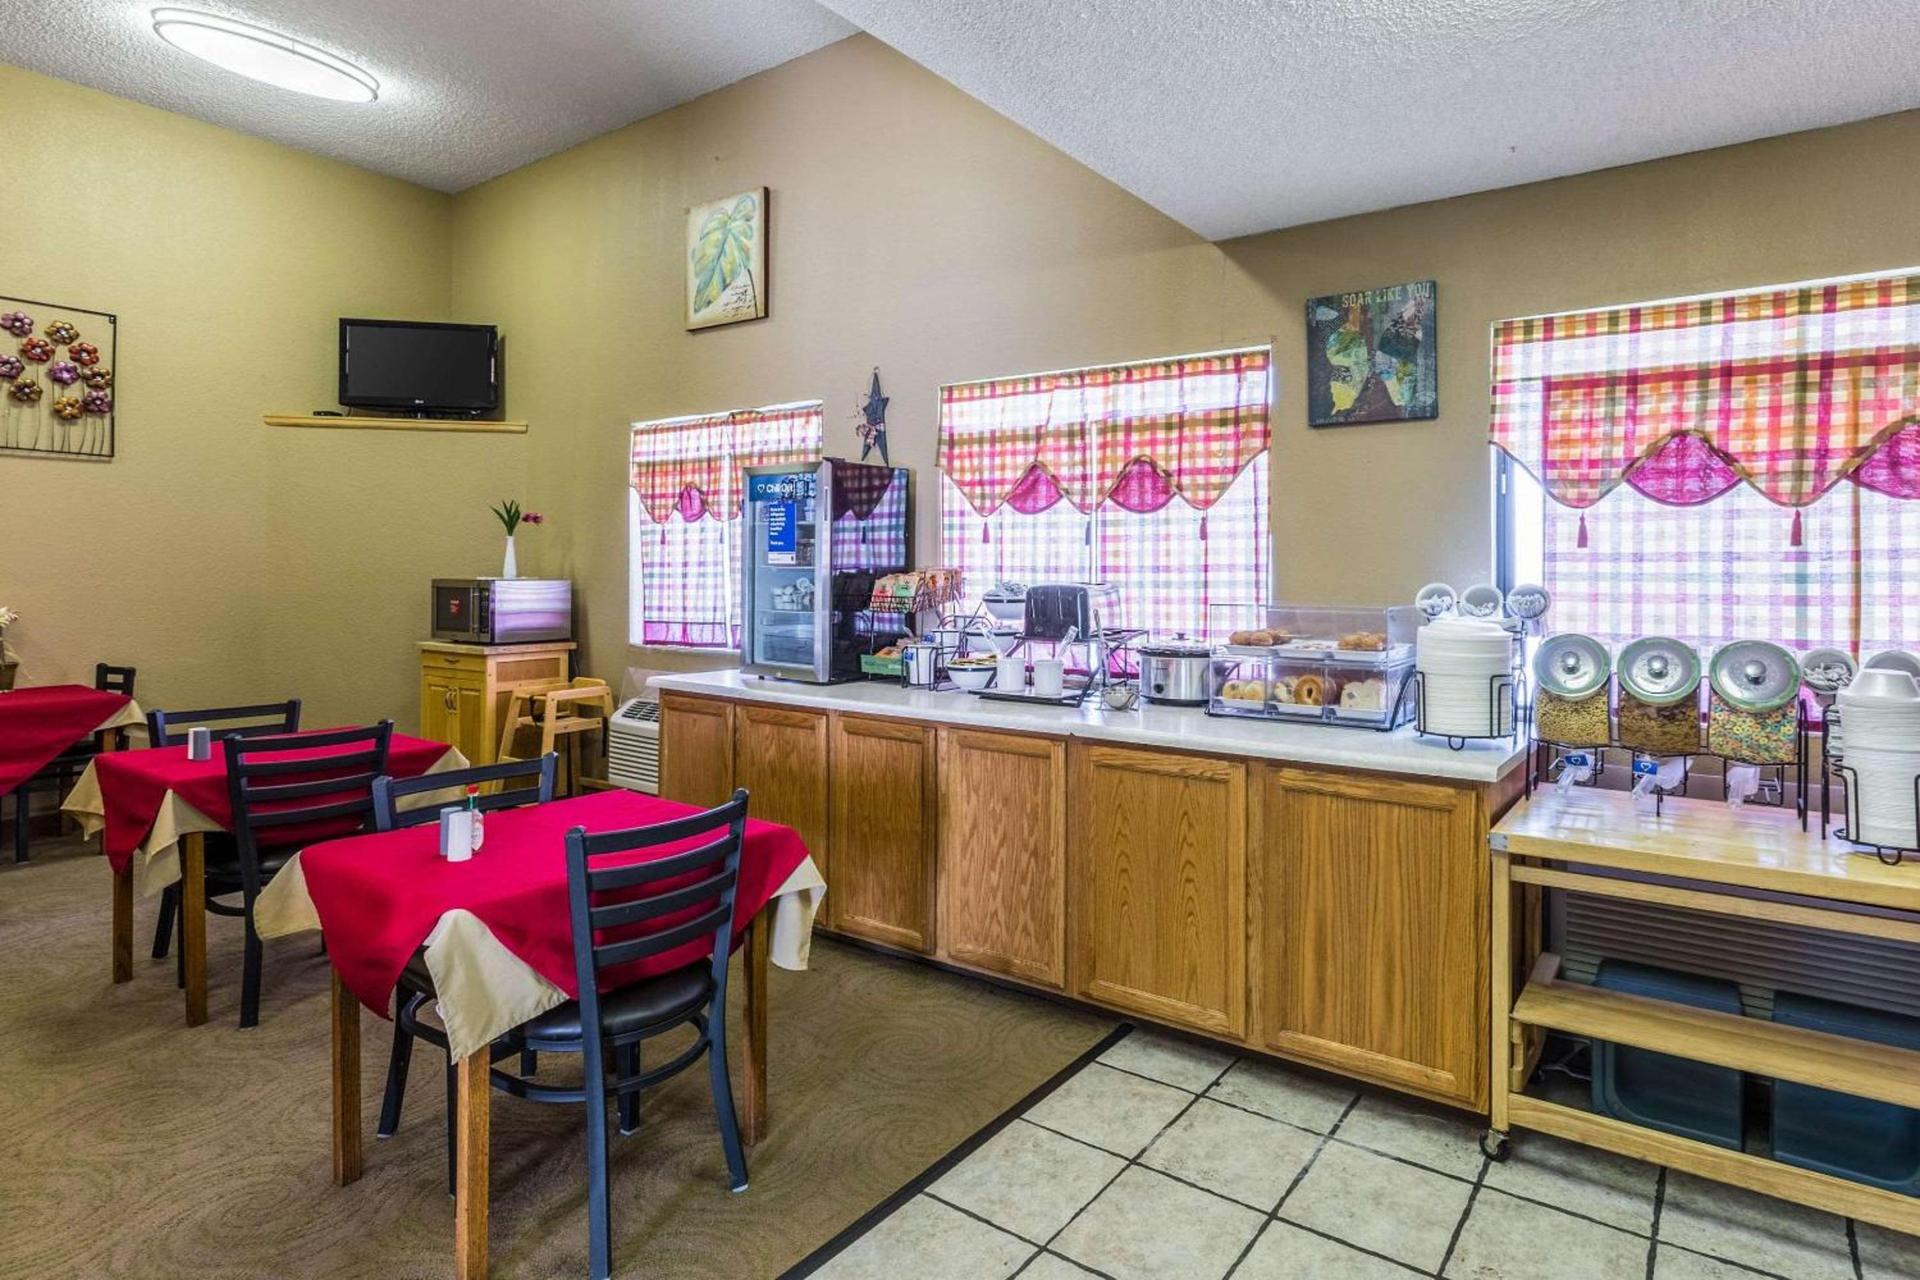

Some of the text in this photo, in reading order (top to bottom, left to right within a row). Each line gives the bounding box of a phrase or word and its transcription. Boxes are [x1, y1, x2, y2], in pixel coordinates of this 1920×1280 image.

[1342, 282, 1431, 308] SOAR LIKE YOU
